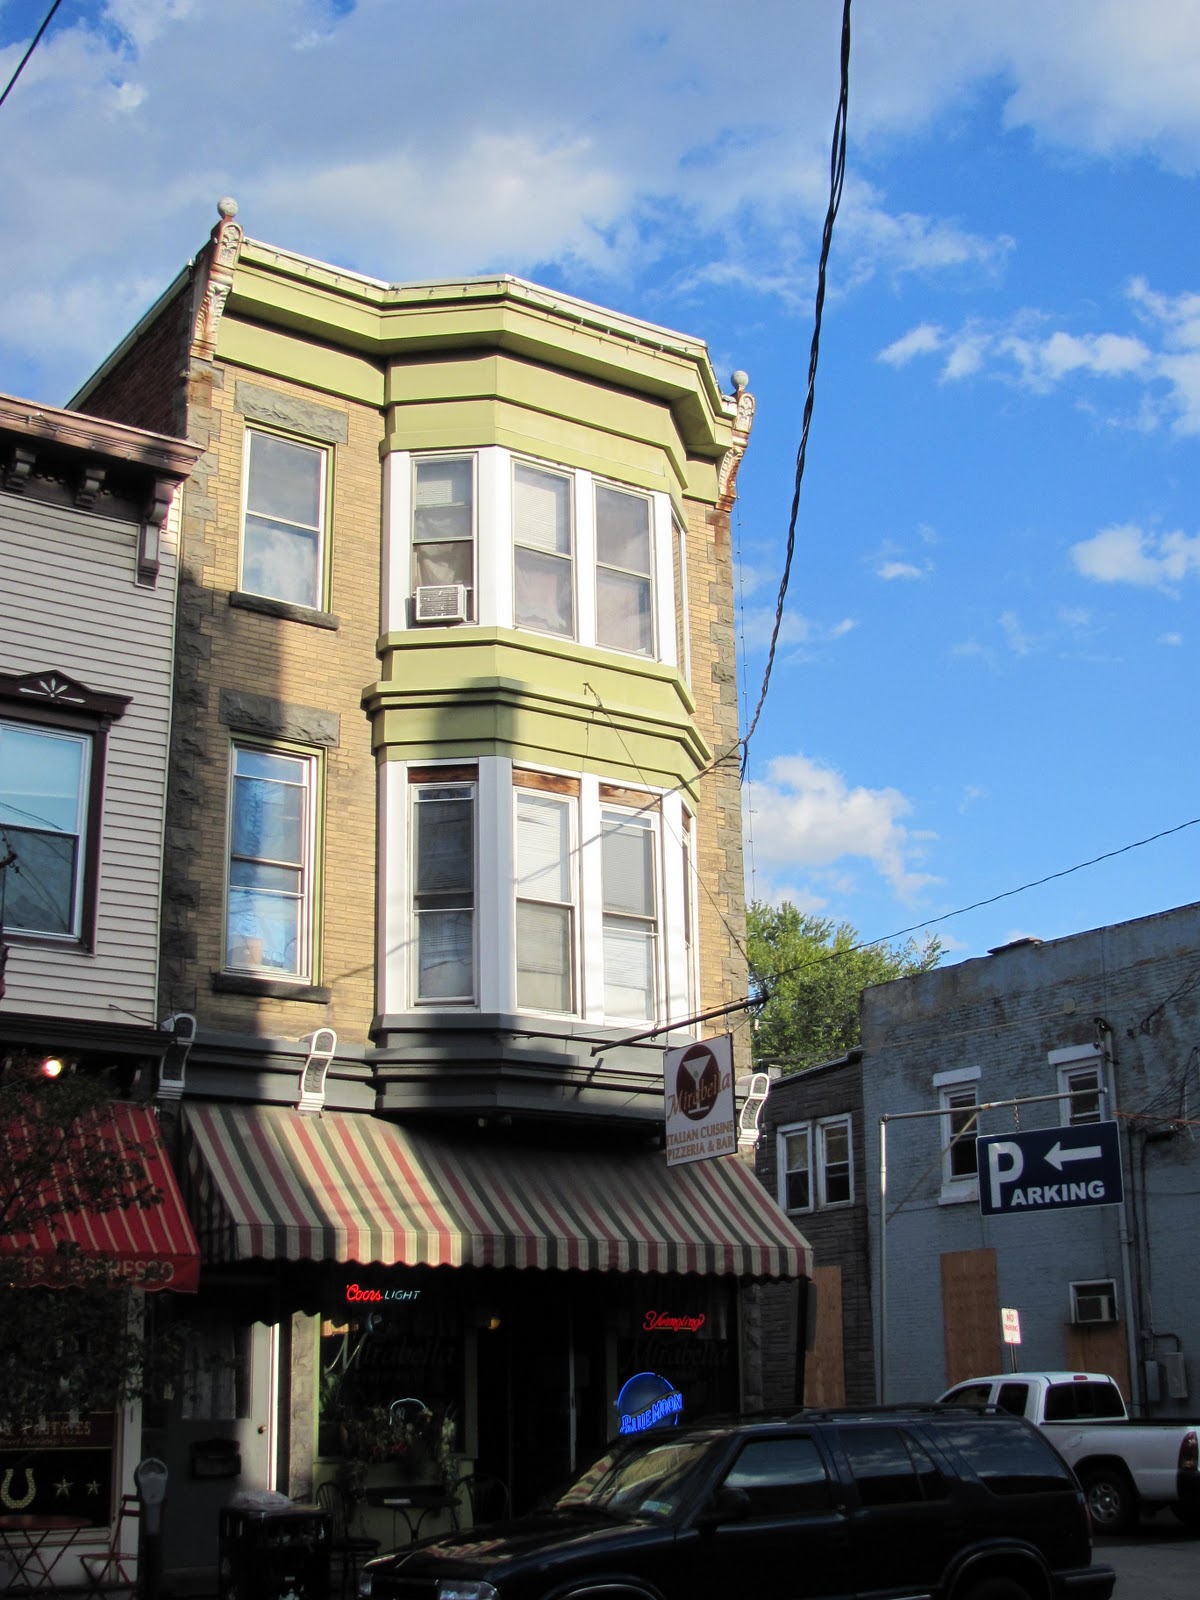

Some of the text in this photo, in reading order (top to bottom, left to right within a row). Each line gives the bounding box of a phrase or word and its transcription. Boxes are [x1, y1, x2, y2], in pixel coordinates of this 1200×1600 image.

[667, 1071, 731, 1121] Mirabella
[666, 1120, 734, 1146] ITALIAN CUISINE
[667, 1135, 734, 1161] PIZZERIA & BAR
[987, 1140, 1106, 1209] PARKING
[346, 1283, 421, 1301] Coors LIGHT
[643, 1310, 706, 1332] Yuengling
[1006, 1313, 1015, 1323] NO
